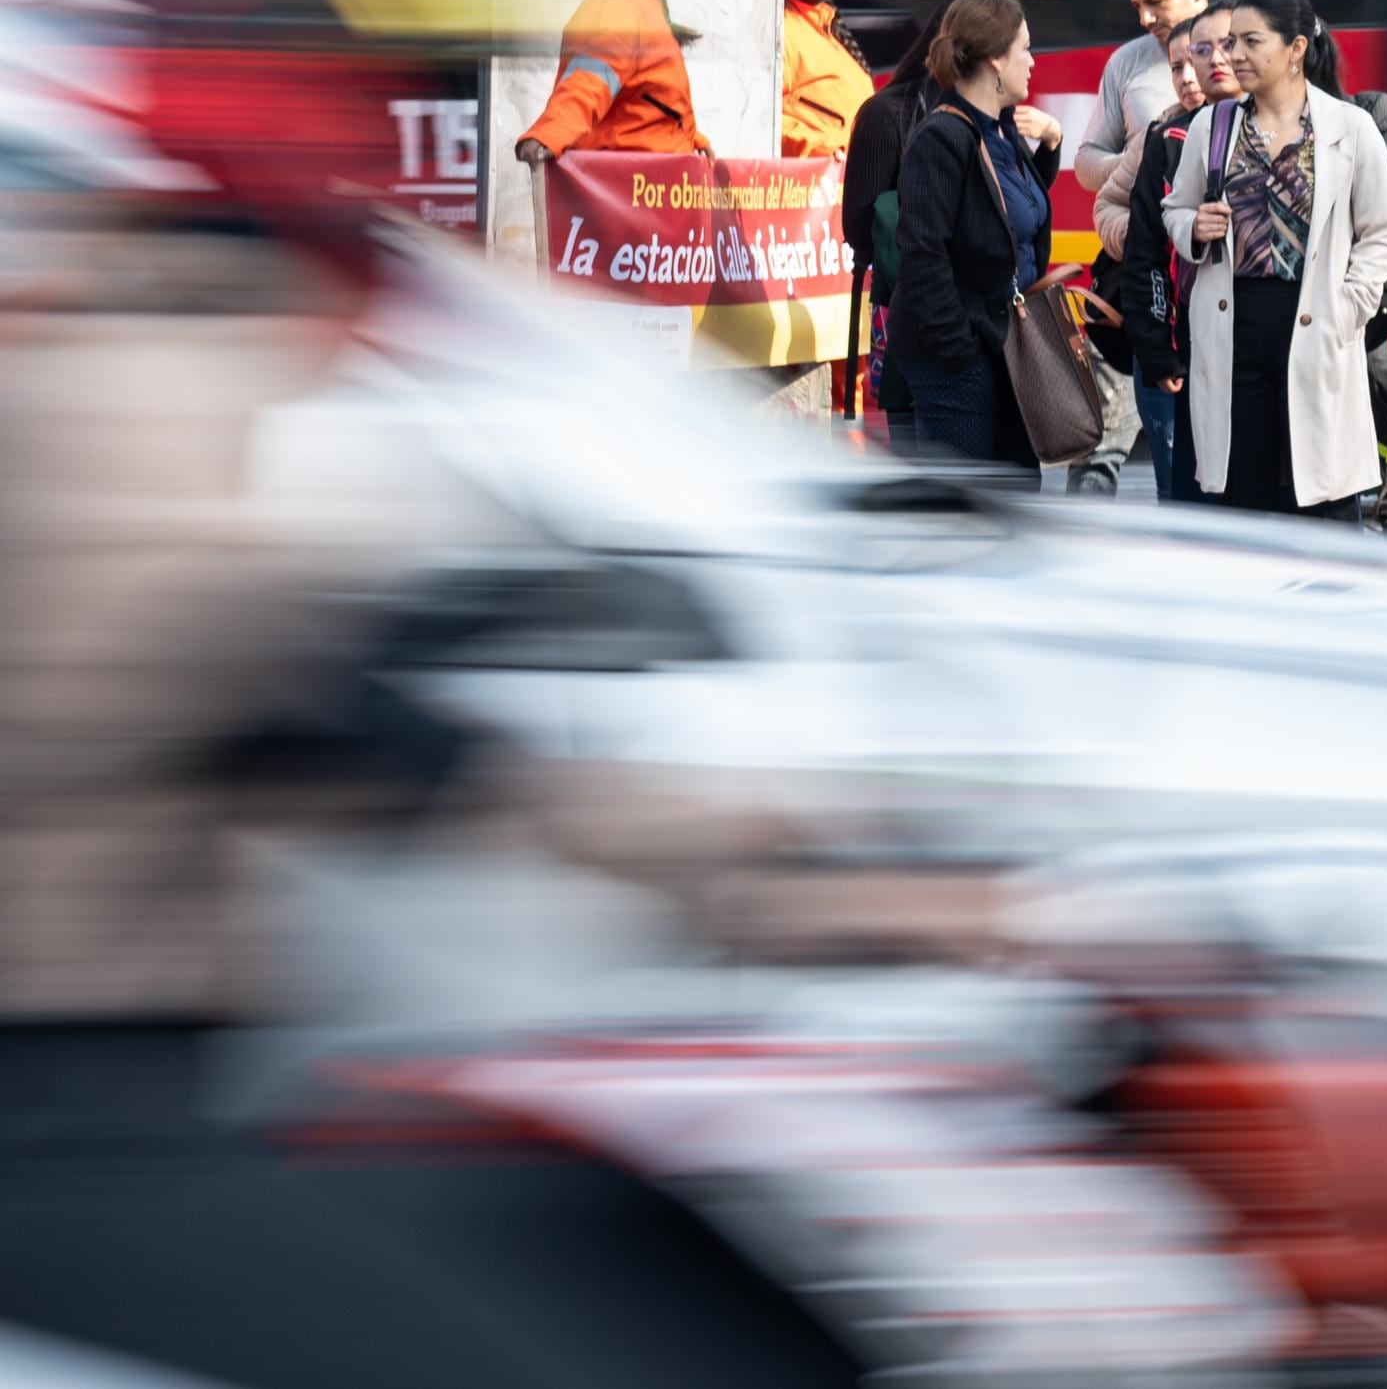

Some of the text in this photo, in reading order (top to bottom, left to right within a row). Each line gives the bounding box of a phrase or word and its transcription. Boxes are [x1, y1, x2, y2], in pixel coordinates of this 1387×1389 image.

[632, 173, 666, 208] Por
[765, 174, 782, 210] del
[556, 215, 600, 276] la
[609, 226, 717, 284] estación
[717, 225, 753, 282] Calle
[767, 223, 818, 296] dejará
[820, 219, 840, 276] de
